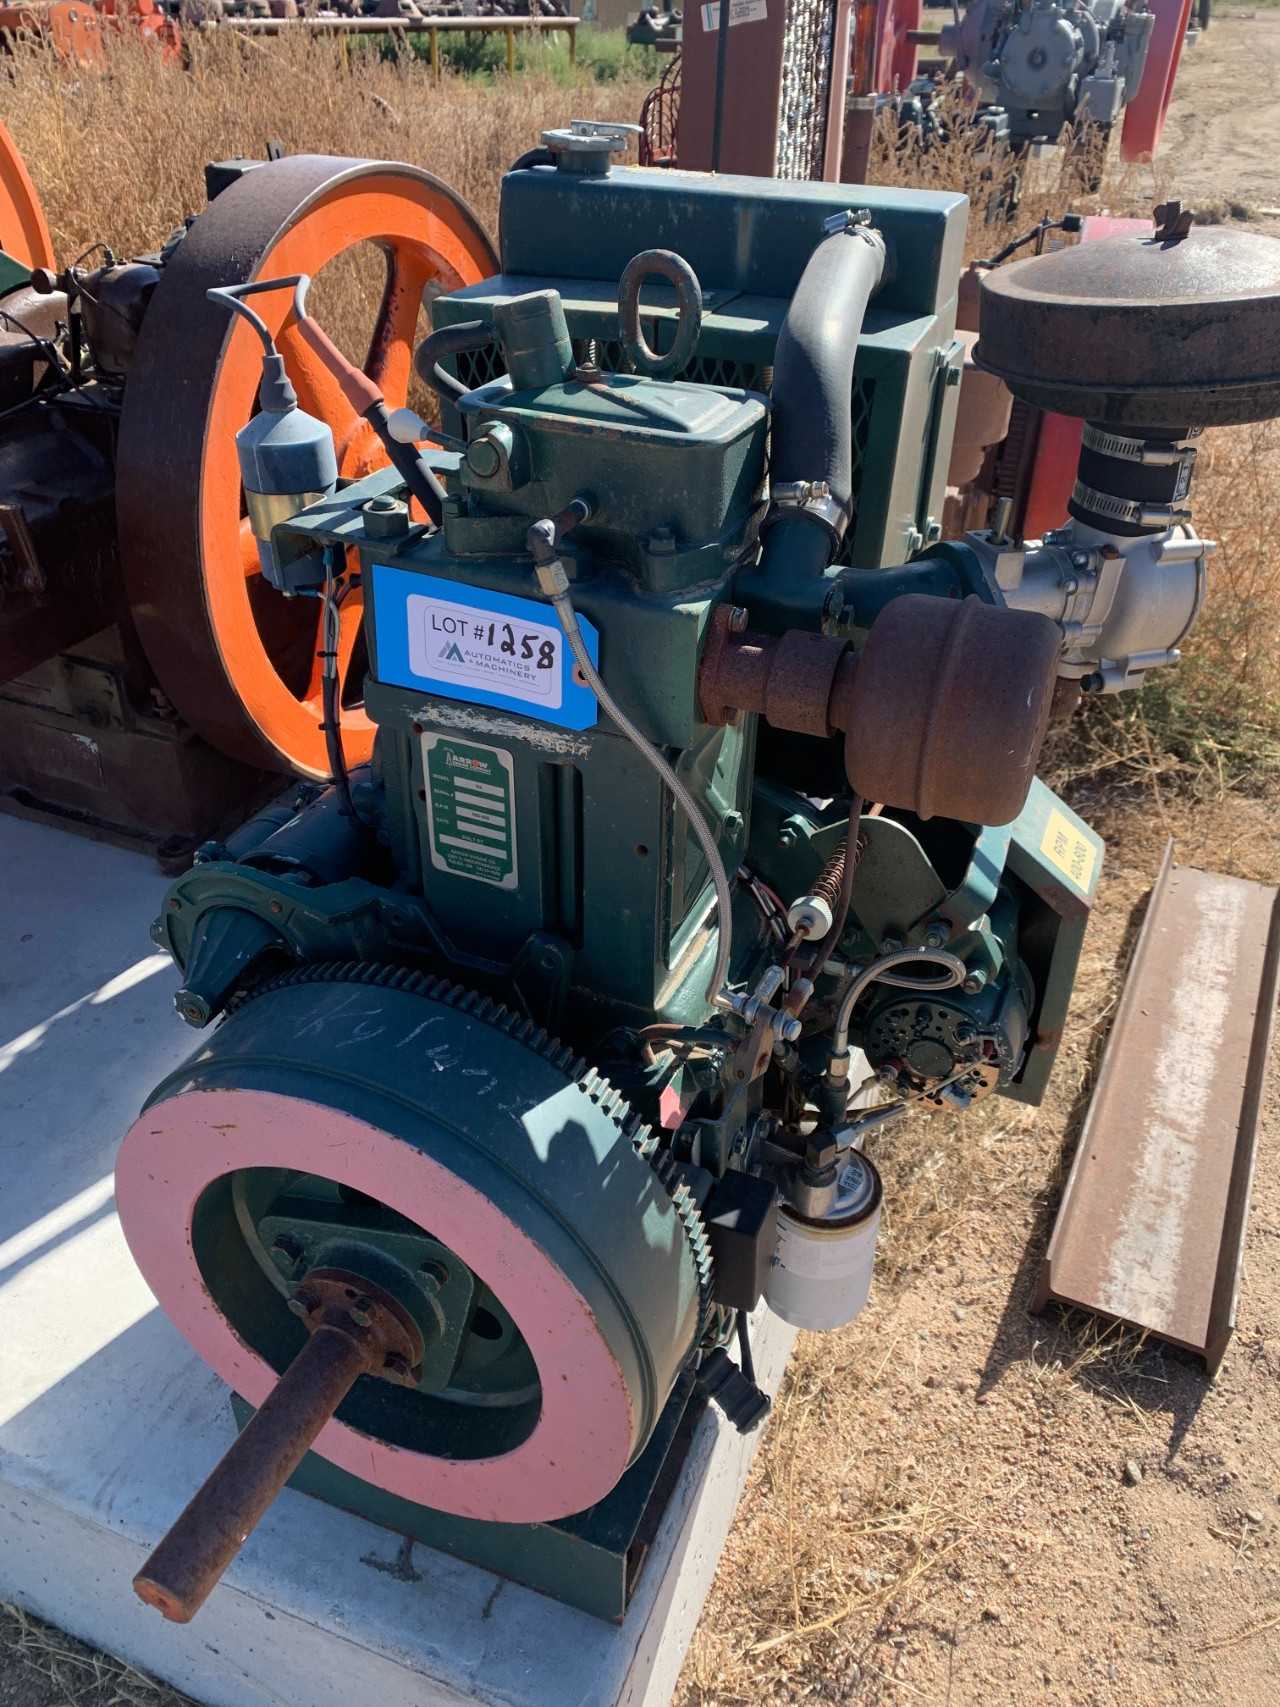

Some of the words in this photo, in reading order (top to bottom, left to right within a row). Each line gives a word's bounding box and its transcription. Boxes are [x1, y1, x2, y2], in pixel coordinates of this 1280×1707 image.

[431, 614, 469, 637] LOT
[464, 649, 531, 672] AUTOMATICS
[474, 660, 537, 681] MACHINERY
[452, 753, 489, 769] ARROW
